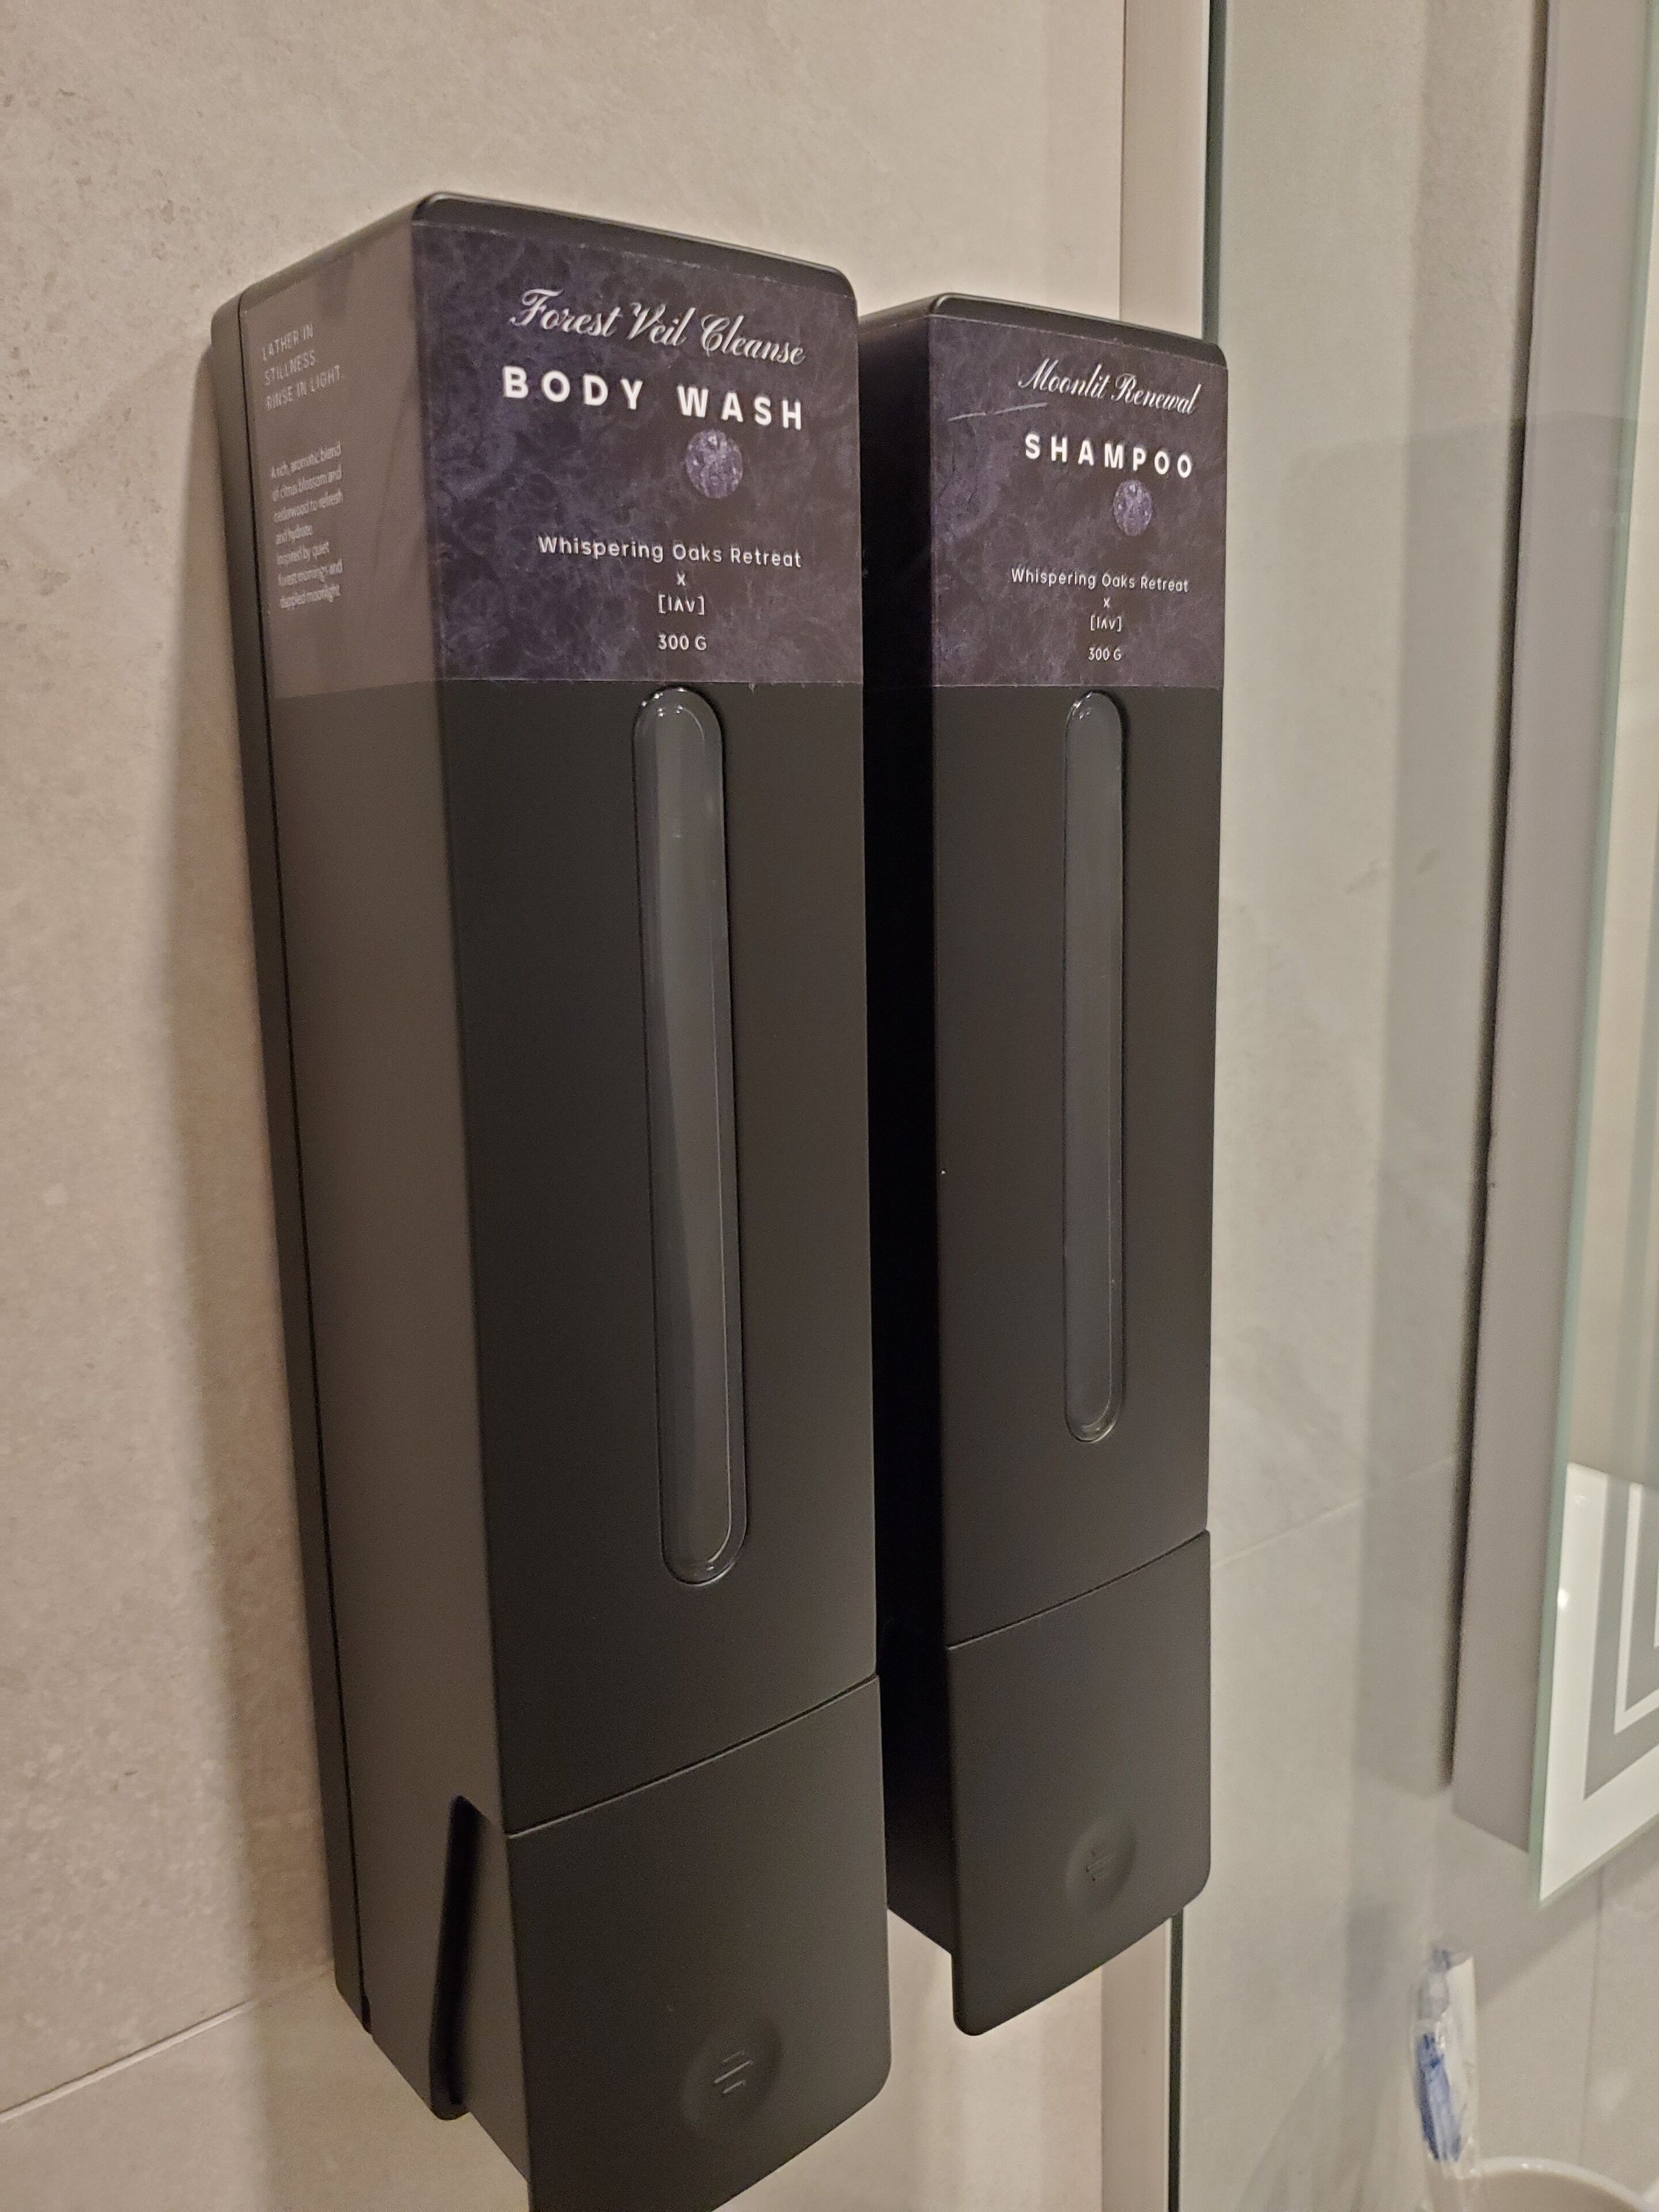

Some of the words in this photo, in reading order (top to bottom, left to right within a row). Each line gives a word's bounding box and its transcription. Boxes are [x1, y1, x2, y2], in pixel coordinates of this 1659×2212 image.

[303, 324, 313, 341] IN
[510, 288, 620, 338] Forest
[627, 303, 696, 346] Veil
[700, 313, 806, 366] Cleanse
[503, 366, 643, 410] BODY
[677, 385, 802, 430] WASH
[1018, 358, 1111, 400] Moonlit
[1111, 373, 1202, 415] Renewal
[1025, 433, 1192, 478] SHAMPOO
[538, 534, 663, 563] Whispering
[673, 542, 722, 562] Oaks
[730, 544, 802, 567] Retreat
[1012, 566, 1095, 590] Whispering
[1101, 572, 1135, 589] Oaks
[1141, 575, 1188, 592] Retreat
[658, 633, 689, 650] 300
[694, 635, 707, 651] G
[1088, 647, 1109, 661] 300
[1113, 648, 1122, 661] G
